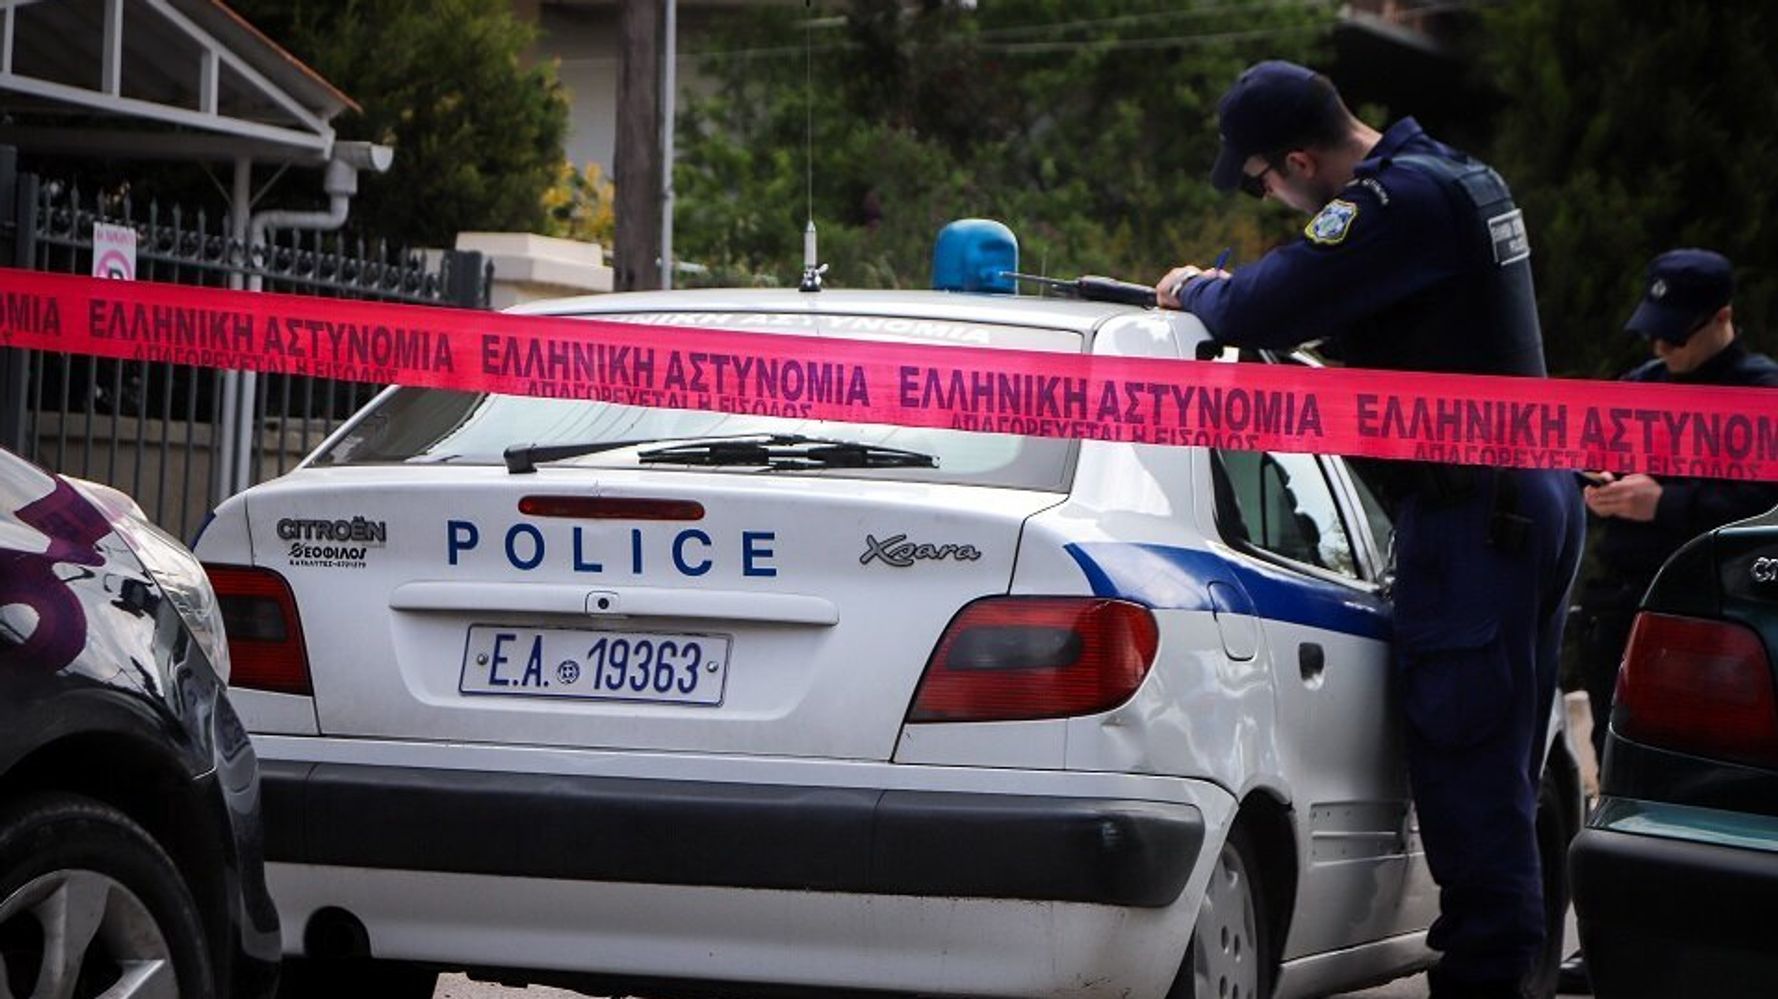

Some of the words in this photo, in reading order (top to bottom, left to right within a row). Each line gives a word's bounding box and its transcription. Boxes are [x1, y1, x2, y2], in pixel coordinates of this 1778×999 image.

[88, 298, 254, 353] ΕΛΛΗΝΙΚΗ
[262, 316, 455, 374] ΑΣΤΥΝΟΜΙΑ
[481, 333, 655, 393] ΕΛΛΗΝΙΚΗ
[663, 350, 871, 408] ΑΣΤΥΝΟΜΙΑ
[899, 365, 1088, 420] ΕΛΛΗΝΙΚΗ
[1098, 379, 1325, 438] ΑΣΤΥΝΟΜΙΑ
[1356, 393, 1568, 448] ΕΛΛΗΝΙΚΗ
[276, 516, 386, 543] CITROËN
[446, 519, 777, 578] POLICE
[587, 637, 702, 694] 19363
